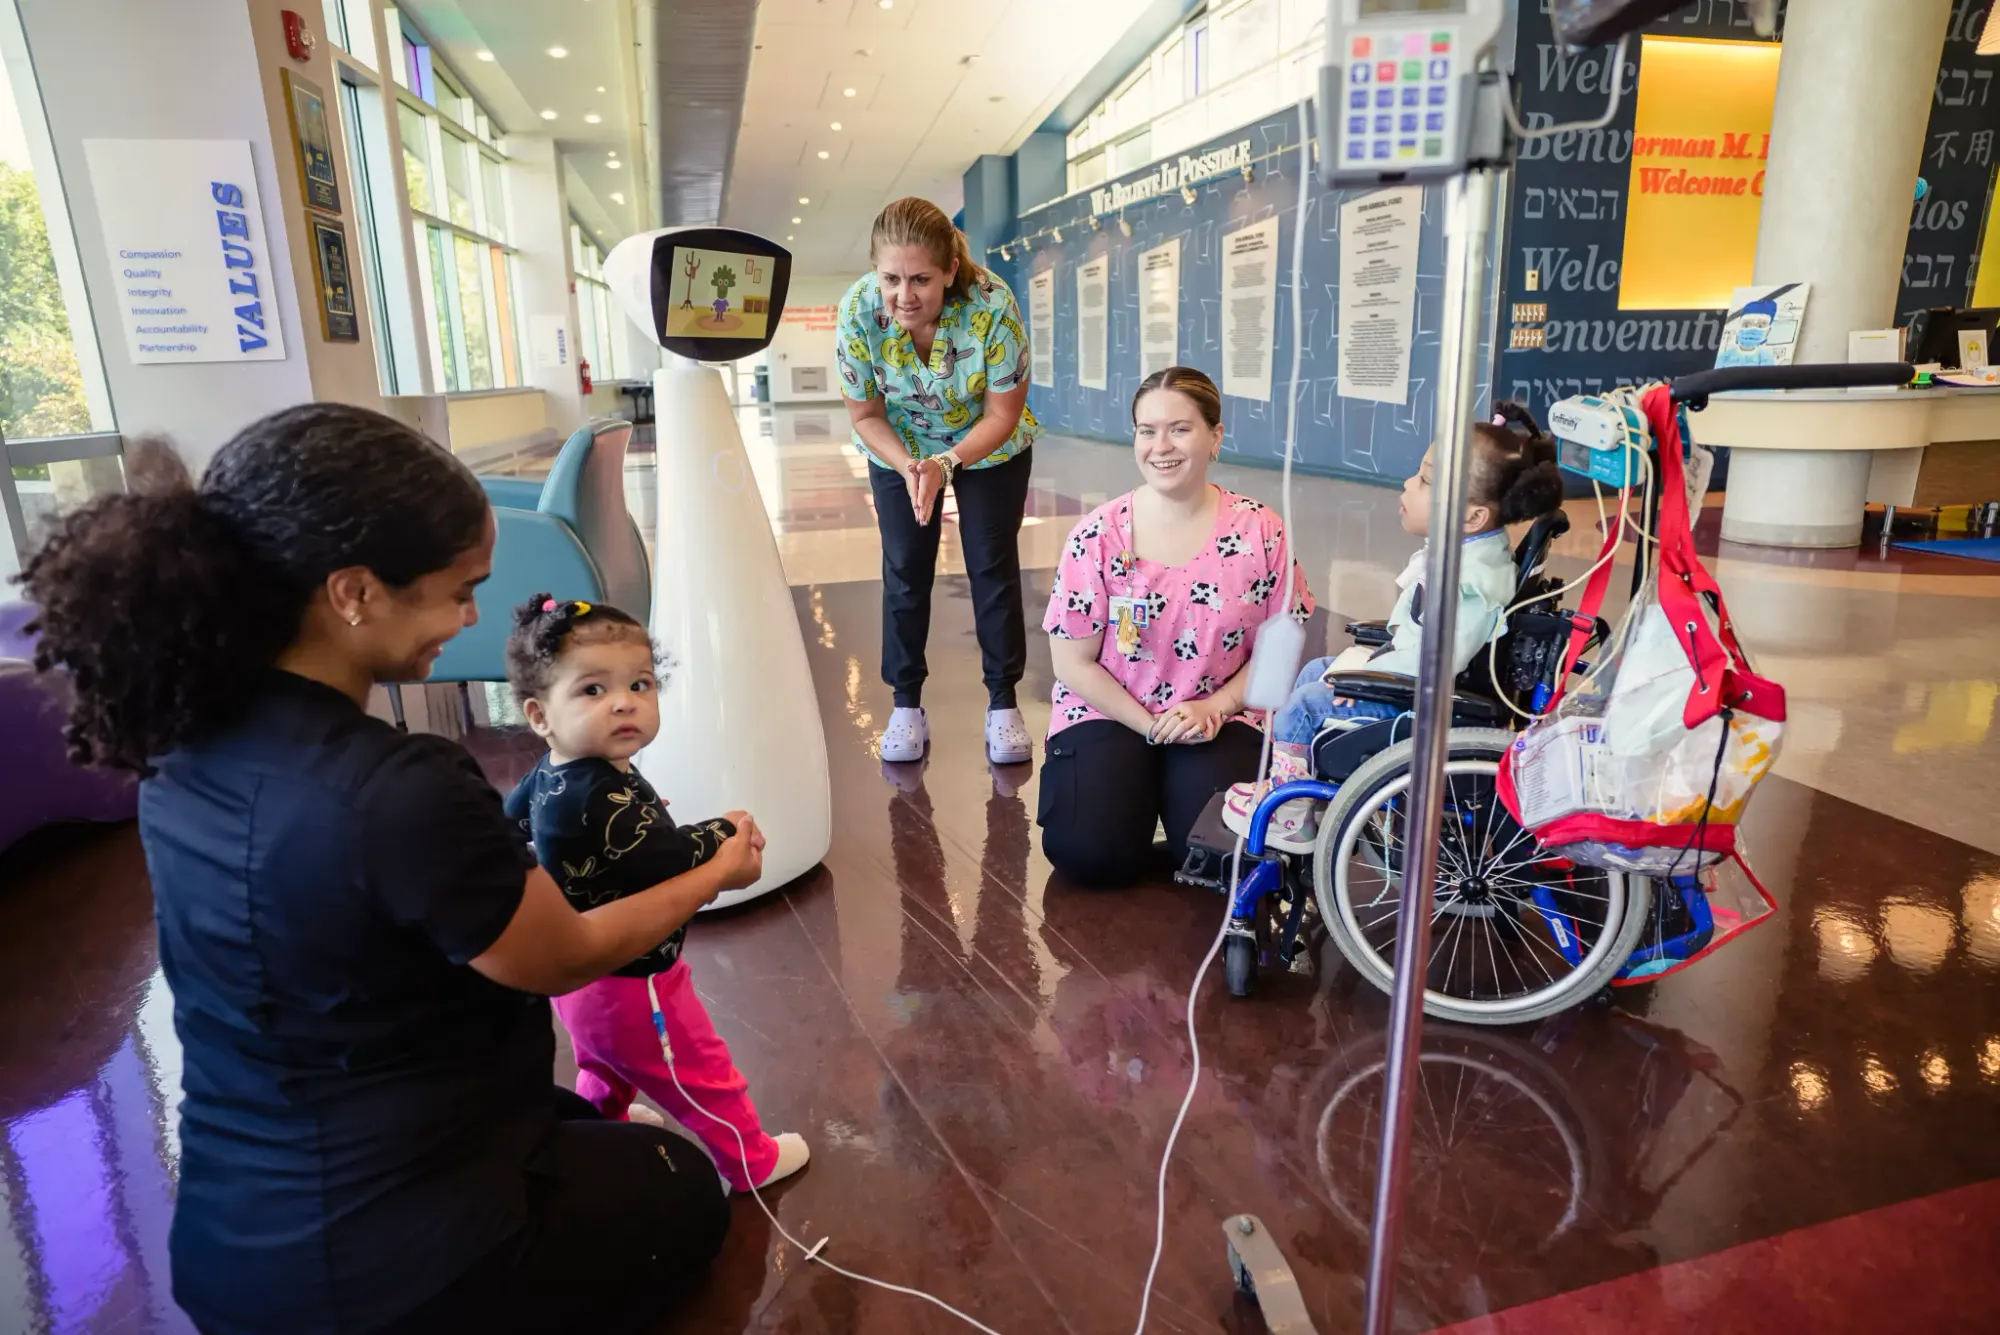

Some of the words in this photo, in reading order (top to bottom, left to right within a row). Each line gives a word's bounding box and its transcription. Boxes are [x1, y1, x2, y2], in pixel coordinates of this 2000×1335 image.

[1632, 131, 1716, 158] orman
[1719, 132, 1753, 159] M.
[1639, 167, 1748, 196] Welcome
[1524, 187, 1619, 220] הבאים
[119, 249, 182, 260] Compassion
[211, 181, 268, 353] VALUES
[123, 268, 162, 280] Quality
[127, 287, 173, 299] Integrity
[131, 306, 187, 316] Innovation
[135, 324, 208, 336] Accountability
[139, 342, 197, 354] Partnership
[1552, 411, 1578, 430] Infinity
